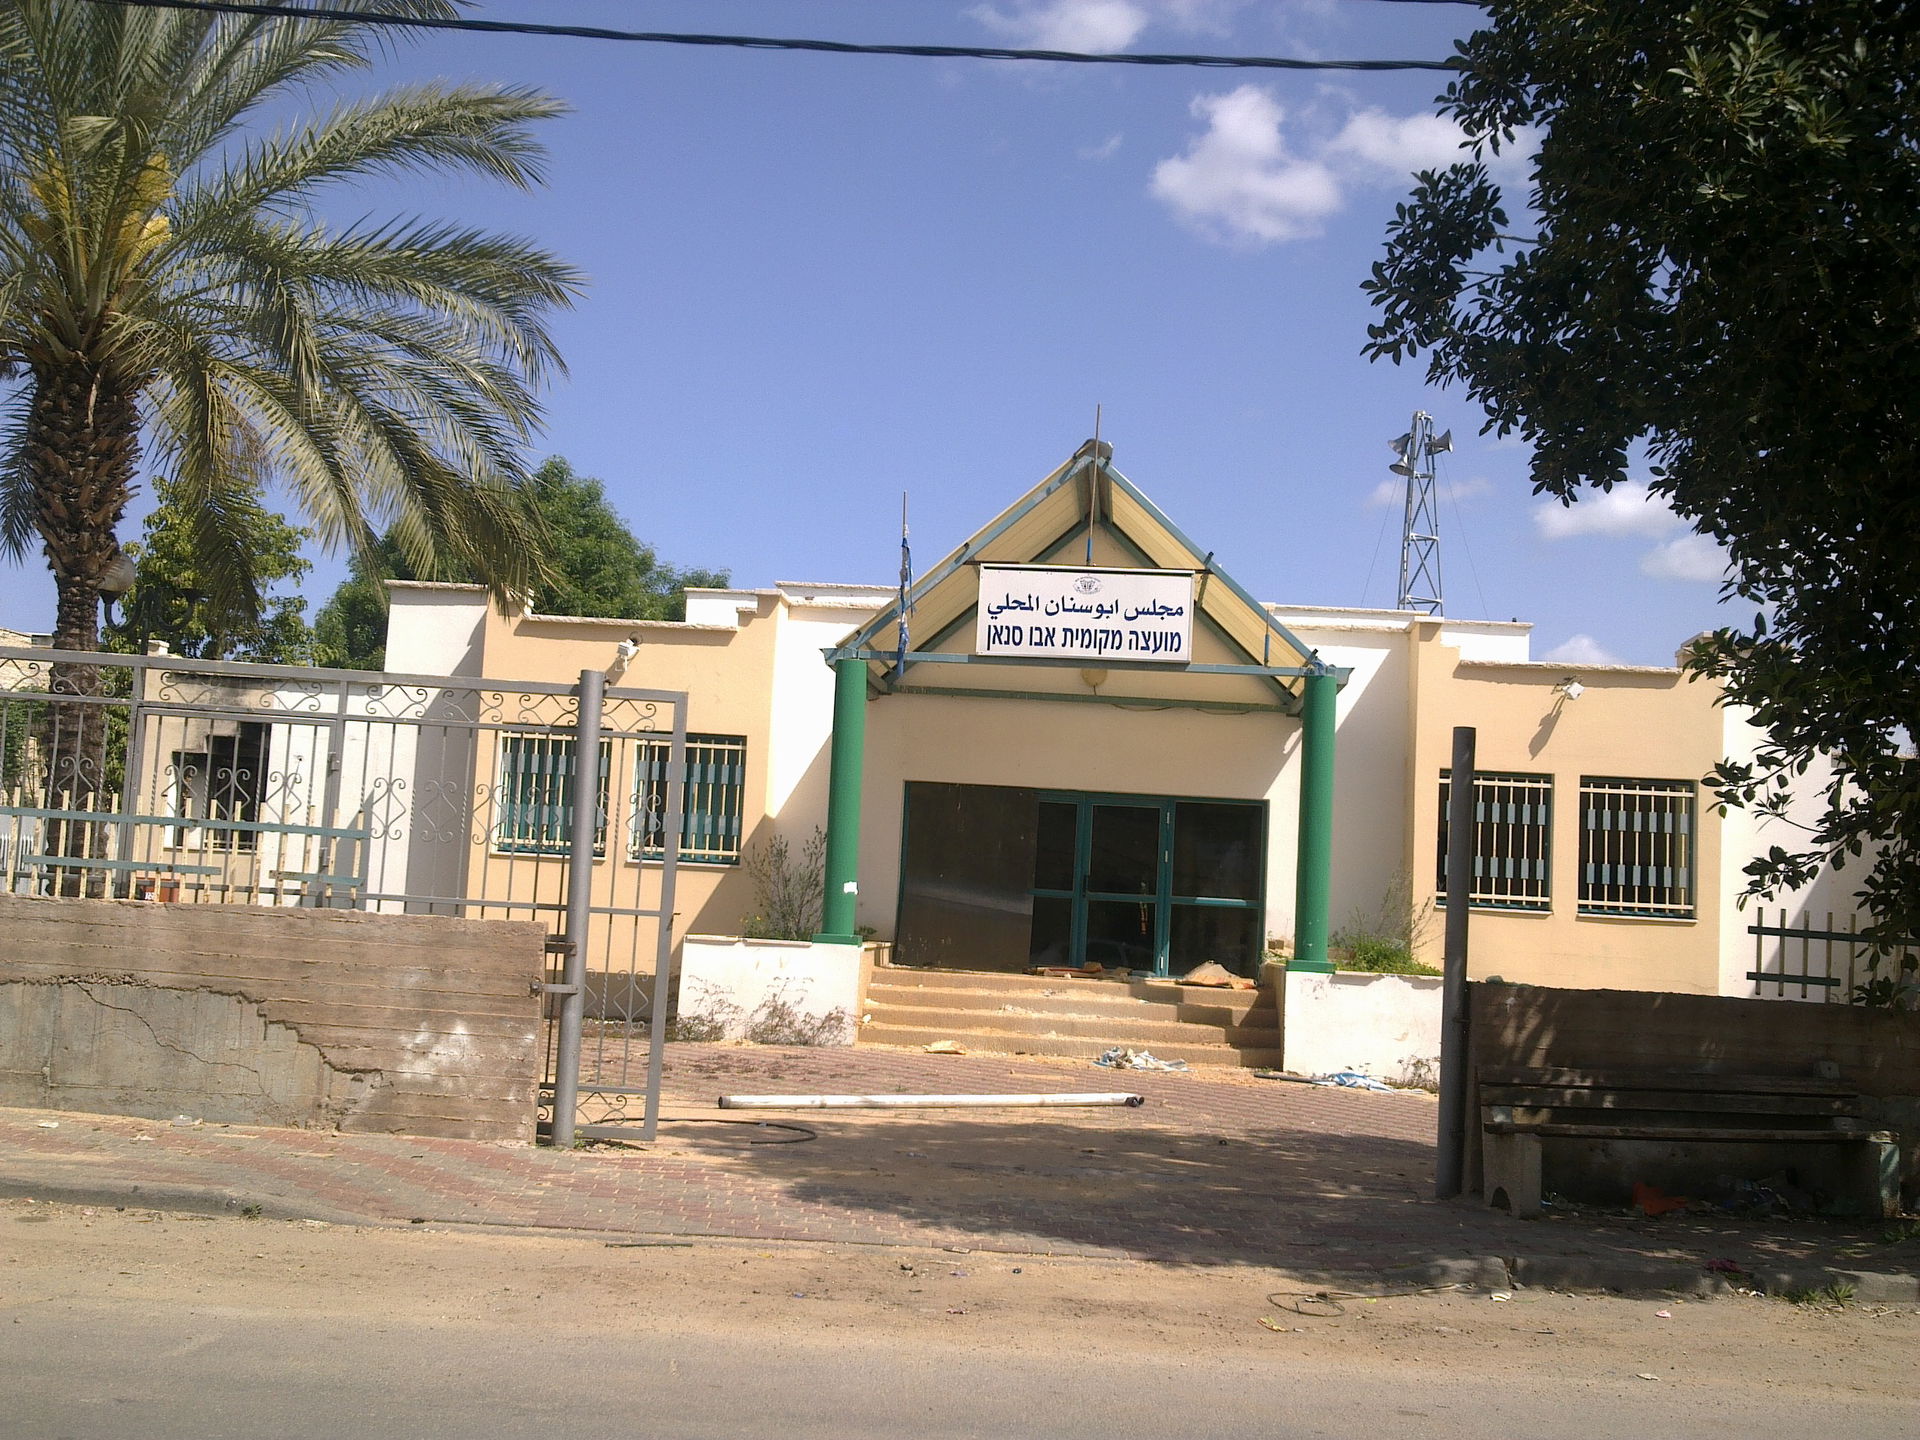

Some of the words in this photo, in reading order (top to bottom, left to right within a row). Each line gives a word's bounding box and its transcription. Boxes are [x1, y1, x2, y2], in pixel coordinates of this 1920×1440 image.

[987, 593, 1040, 620] المحلي
[1124, 598, 1184, 621] مجلس
[987, 624, 1023, 650] סנאן
[1029, 625, 1056, 647] אבו
[1061, 627, 1123, 655] מקומית
[1128, 629, 1182, 654] מועצה
